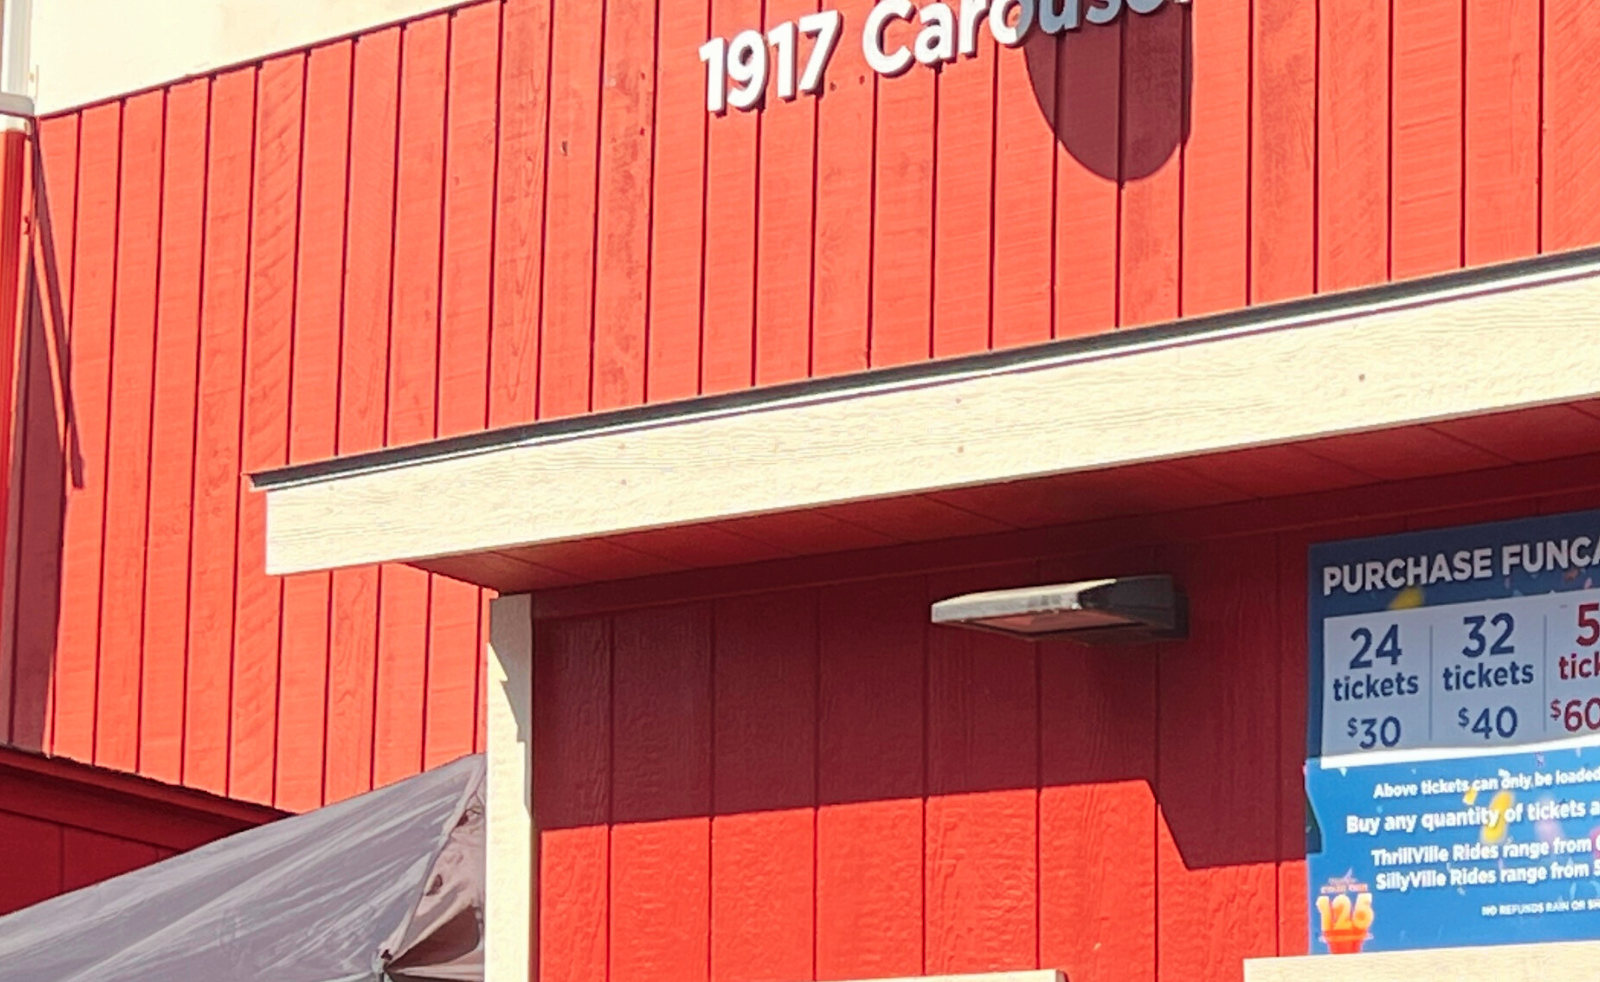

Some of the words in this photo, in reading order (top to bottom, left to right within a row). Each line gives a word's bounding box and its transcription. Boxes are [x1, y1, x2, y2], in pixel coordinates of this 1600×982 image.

[699, 10, 841, 113] 1917
[1323, 548, 1493, 596] PURCHASE
[1349, 624, 1402, 669] 24
[1462, 612, 1515, 658] 32
[1333, 672, 1419, 701] tickets
[1443, 661, 1534, 691] tickets
[1348, 716, 1401, 749] $30
[1458, 705, 1518, 739] $40
[1373, 783, 1418, 799] Above
[1421, 779, 1468, 794] tickets
[1474, 777, 1499, 791] can
[1501, 774, 1532, 789] only
[1535, 771, 1553, 785] be
[1346, 815, 1380, 835] Buy
[1384, 814, 1417, 832] any
[1421, 806, 1499, 831] quantity
[1504, 803, 1523, 822] of
[1527, 800, 1586, 821] tickets
[1371, 845, 1449, 867] ThrillVille
[1453, 843, 1499, 861] Rides
[1503, 842, 1550, 862] range
[1553, 835, 1592, 853] from
[1375, 871, 1447, 892] SillyVille
[1450, 868, 1496, 885] Rides
[1501, 867, 1547, 885] range
[1551, 861, 1590, 879] from
[1481, 905, 1498, 916] NO
[1499, 902, 1544, 915] REFUNDS
